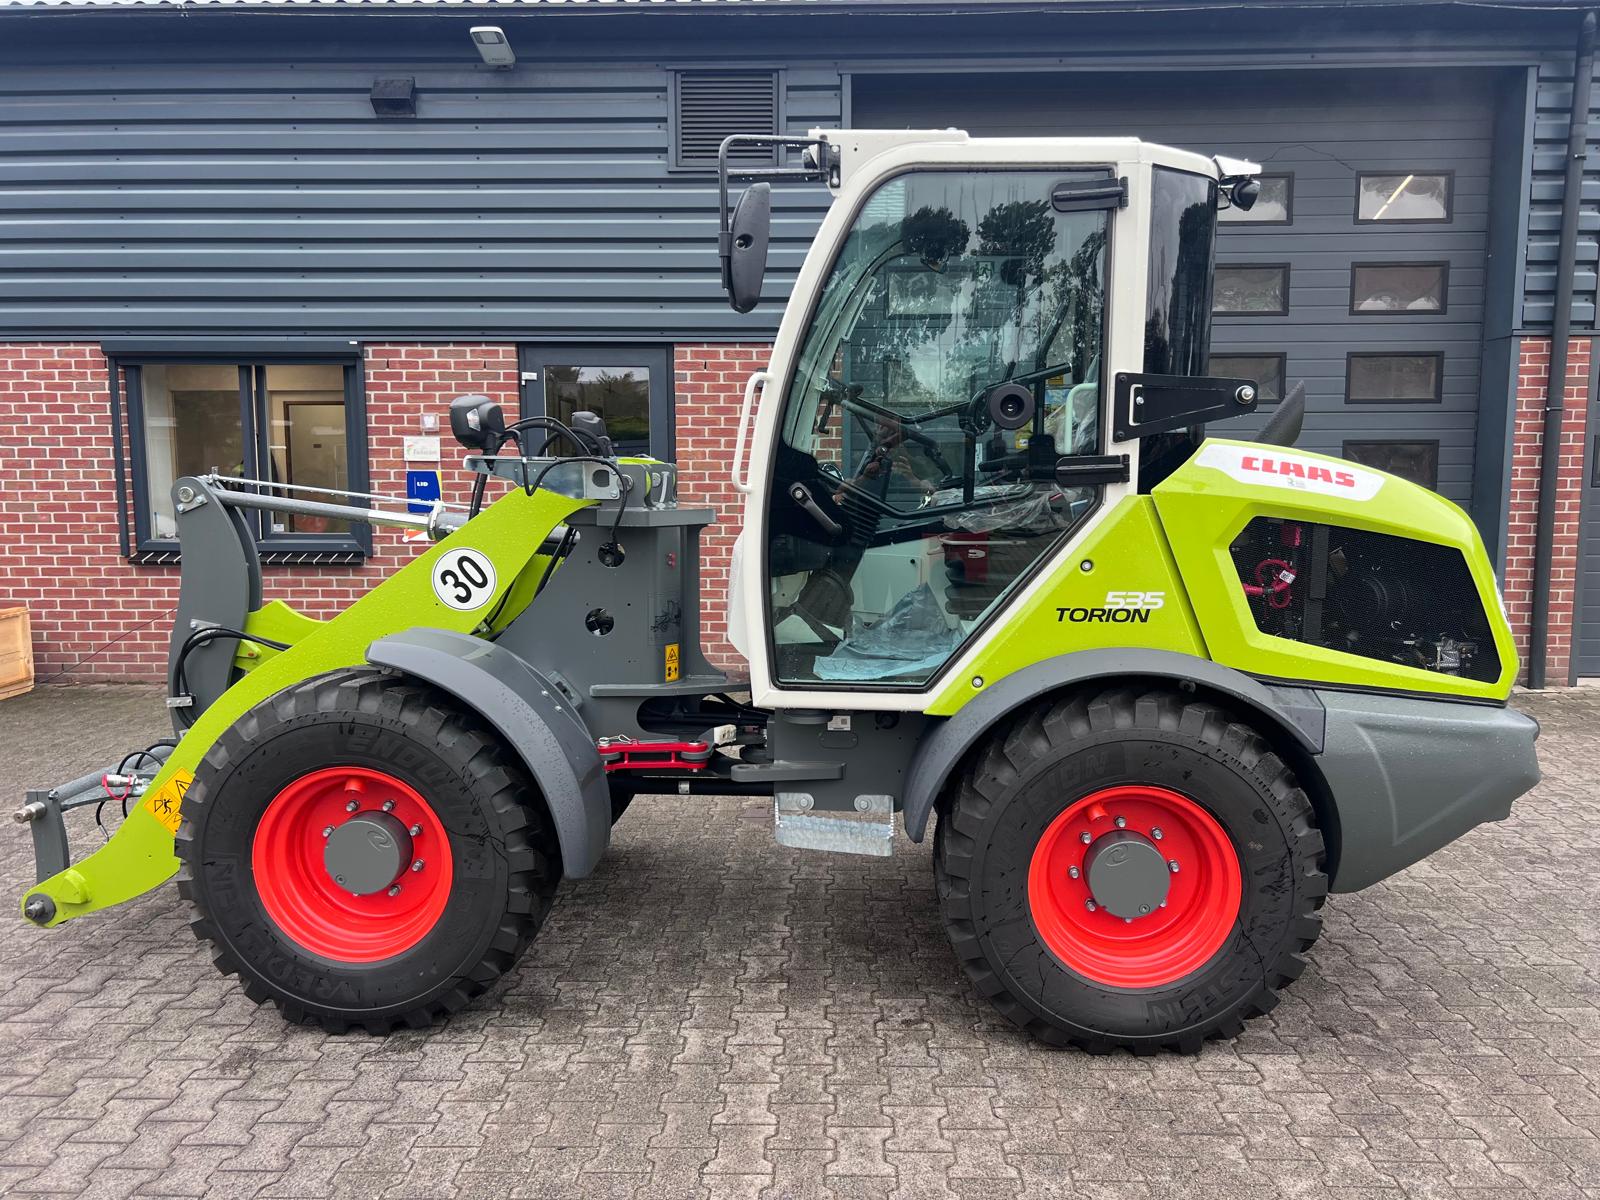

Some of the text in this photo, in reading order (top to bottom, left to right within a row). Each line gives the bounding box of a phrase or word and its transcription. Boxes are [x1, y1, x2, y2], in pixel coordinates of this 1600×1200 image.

[1241, 456, 1355, 488] CLAAS
[440, 555, 488, 604] 30
[1104, 591, 1165, 610] 535
[1056, 607, 1151, 623] TORION
